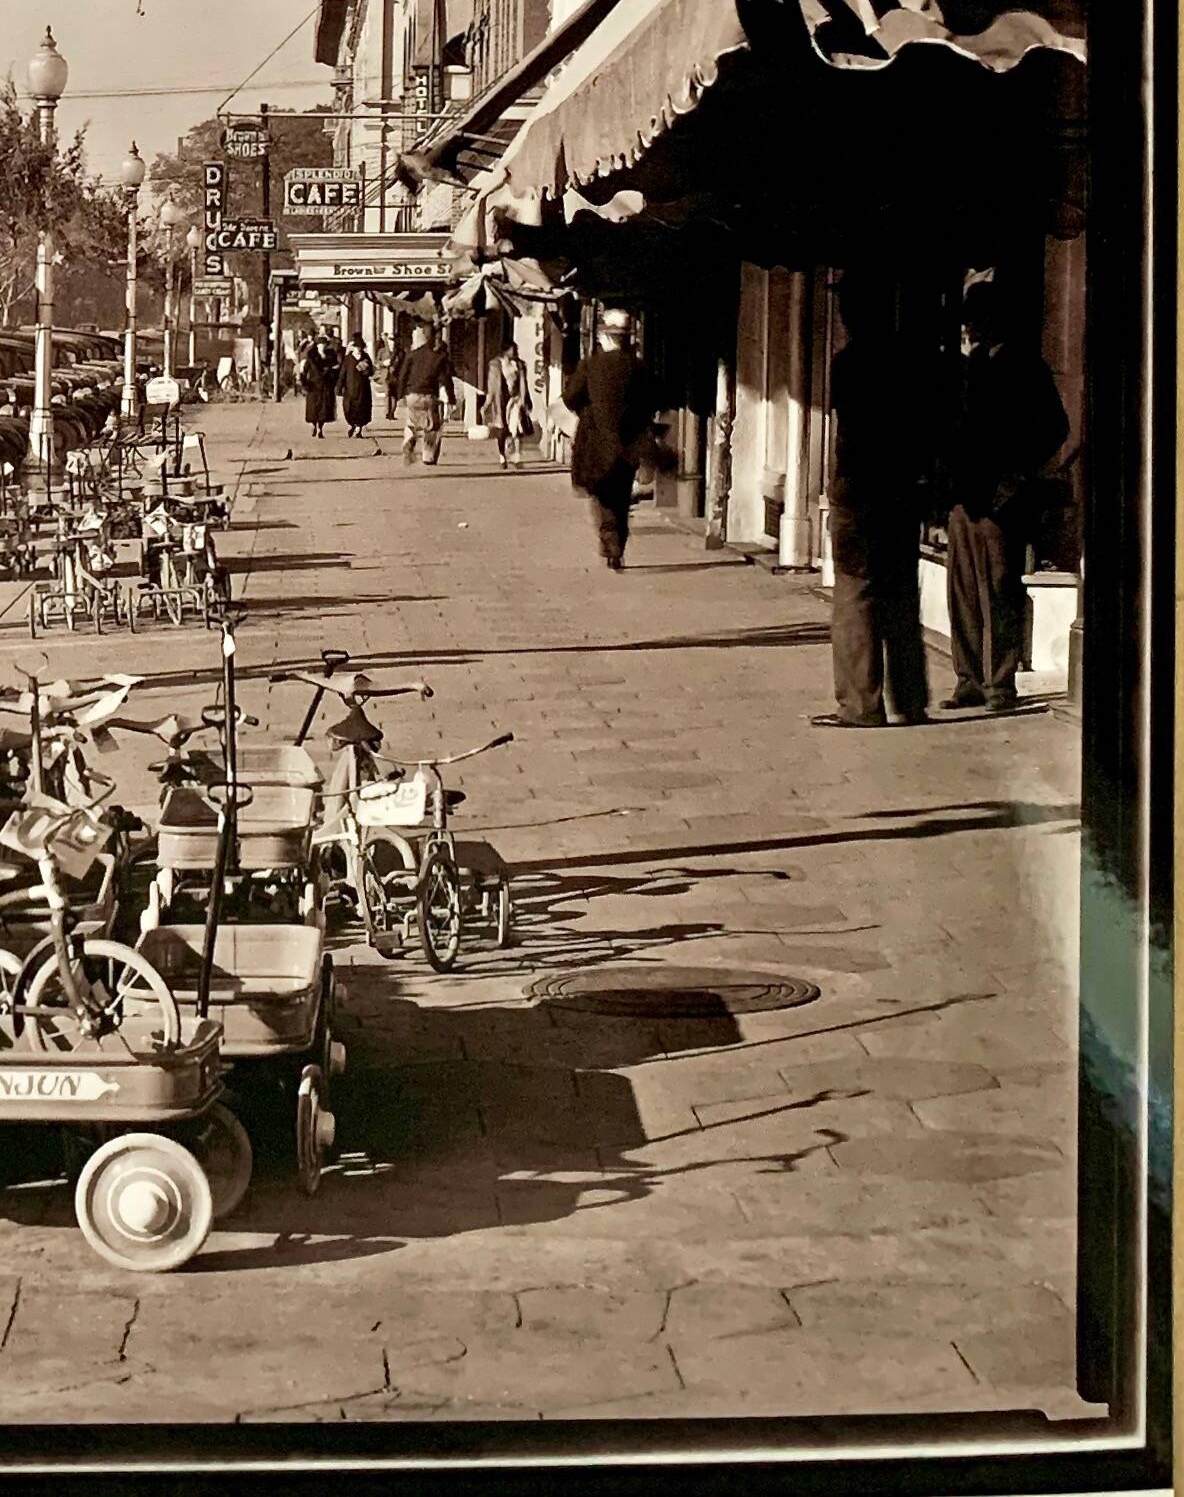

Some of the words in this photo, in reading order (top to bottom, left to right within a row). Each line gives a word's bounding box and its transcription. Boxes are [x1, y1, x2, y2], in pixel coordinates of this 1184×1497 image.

[225, 143, 266, 157] SHOES
[289, 183, 358, 205] CAFE
[217, 231, 275, 248] CAFE
[392, 263, 432, 275] Shoe
